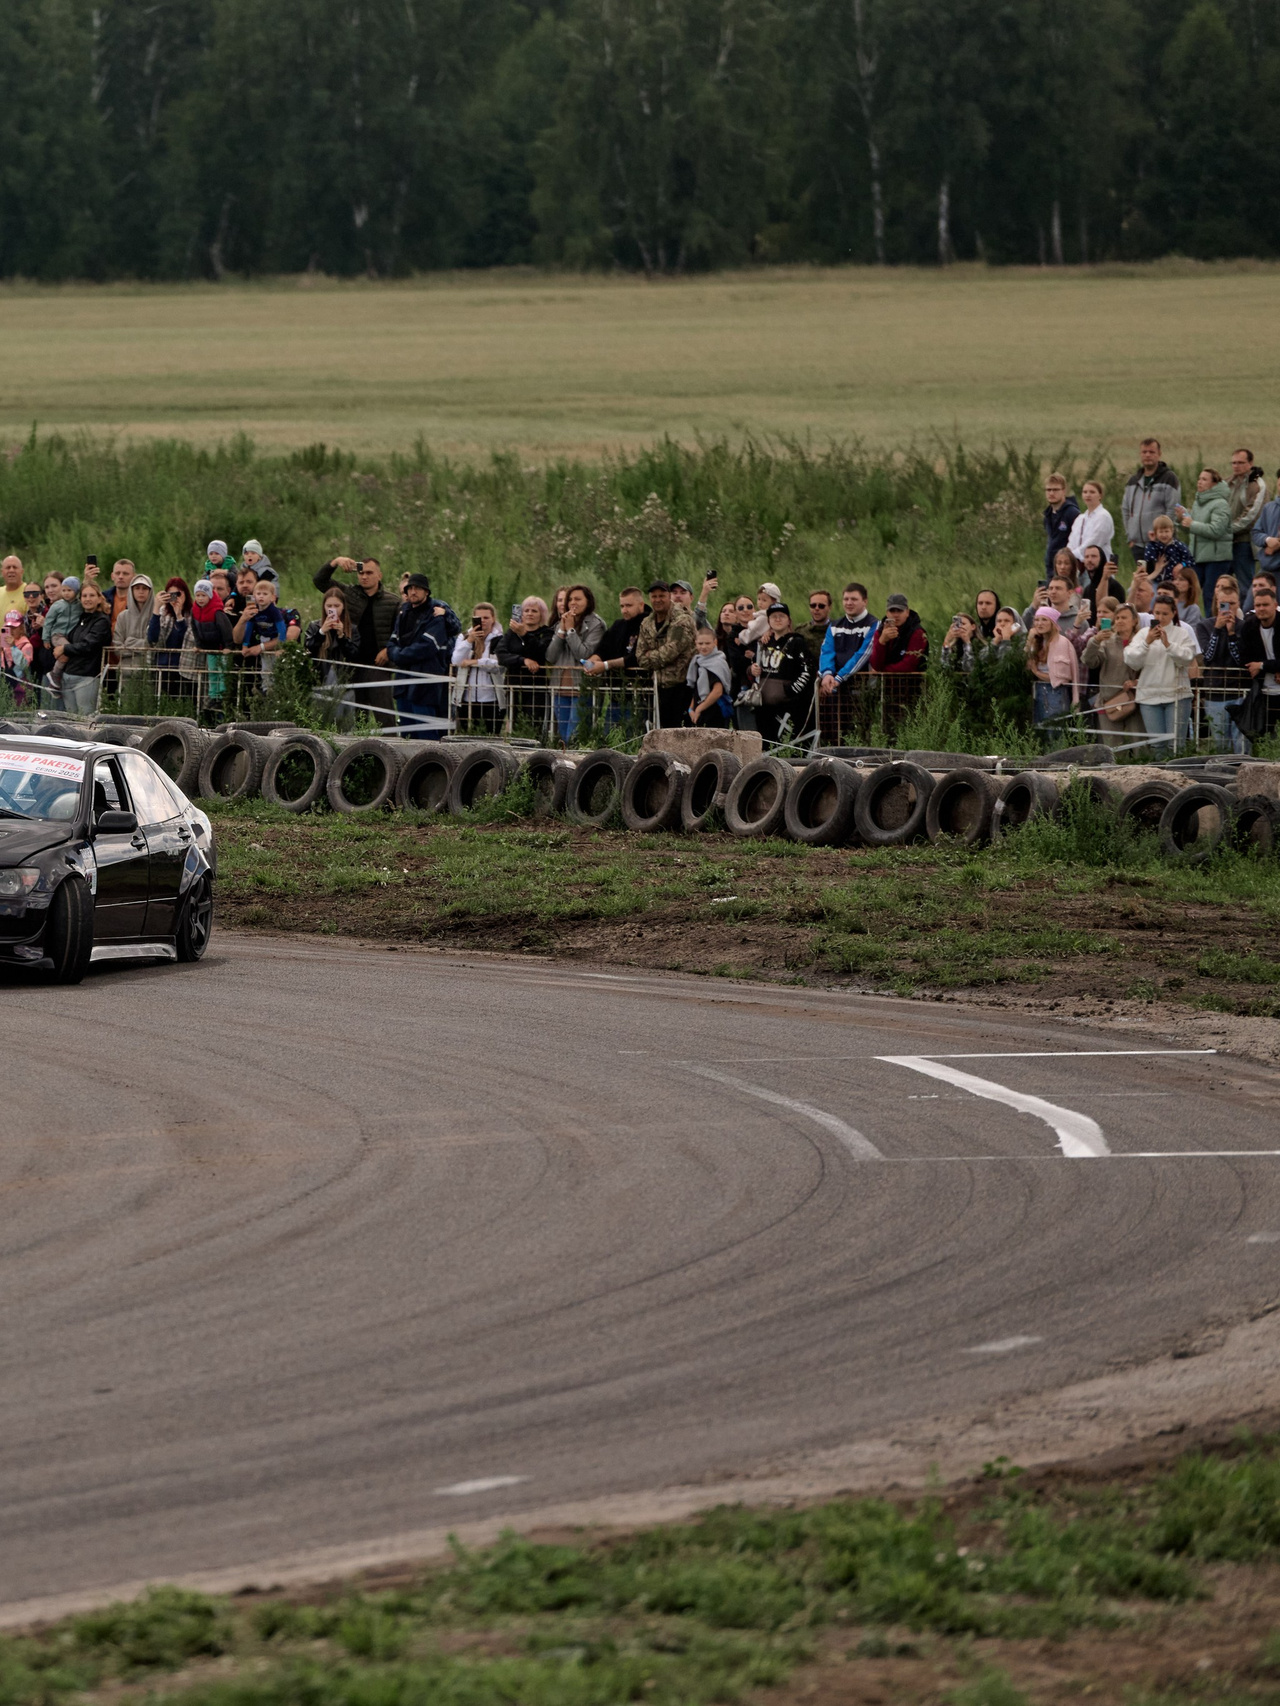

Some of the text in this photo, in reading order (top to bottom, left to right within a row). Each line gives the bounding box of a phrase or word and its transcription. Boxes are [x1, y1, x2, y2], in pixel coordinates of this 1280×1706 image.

[31, 757, 82, 772] РАКЕТЫ
[35, 766, 80, 778] СЕЗОН 2025
